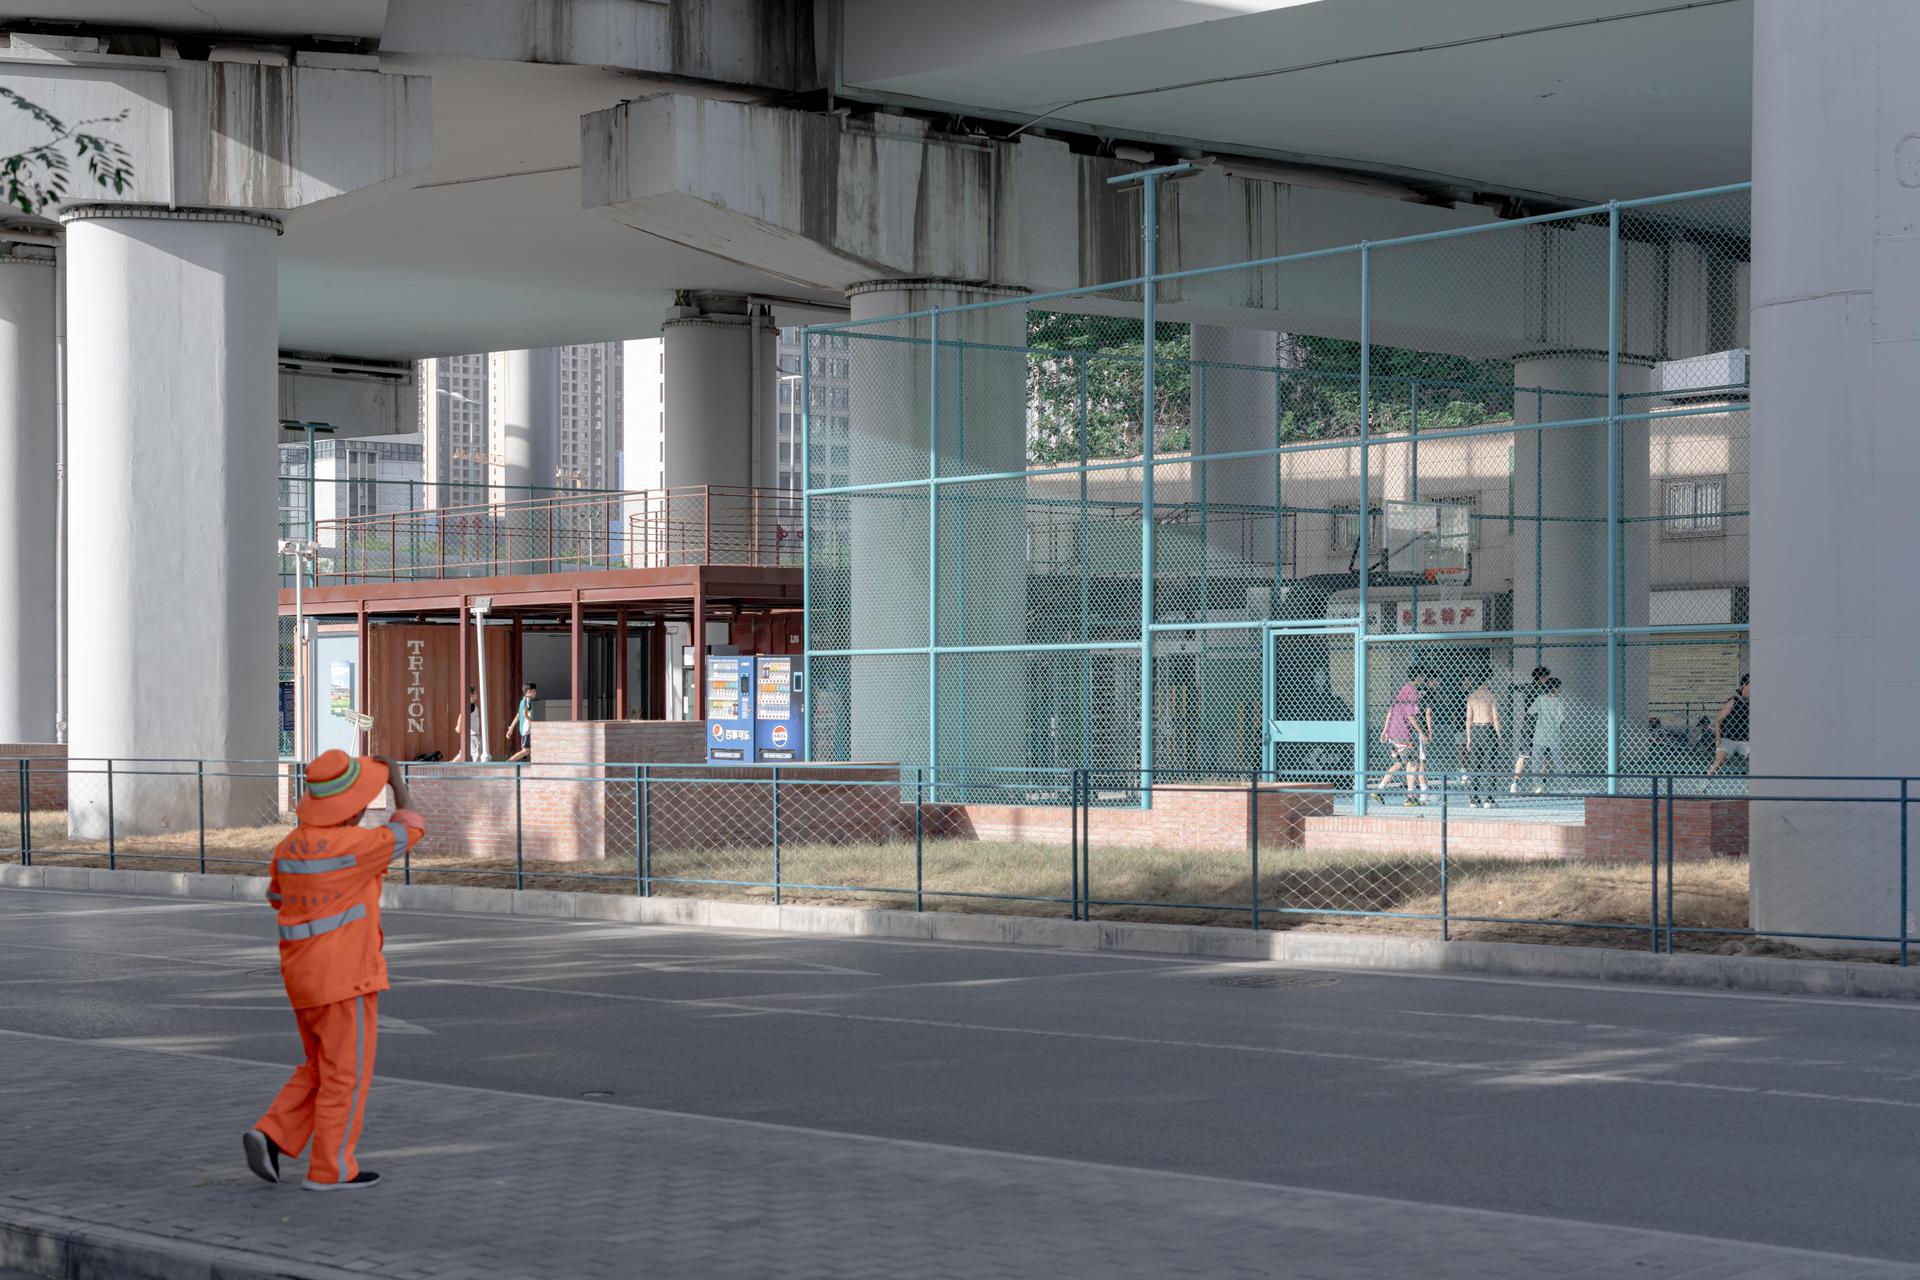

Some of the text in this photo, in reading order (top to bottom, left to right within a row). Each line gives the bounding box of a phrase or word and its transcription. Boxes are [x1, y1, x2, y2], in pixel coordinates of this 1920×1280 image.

[407, 640, 425, 733] TRITON
[725, 729, 750, 740] 百事可乐
